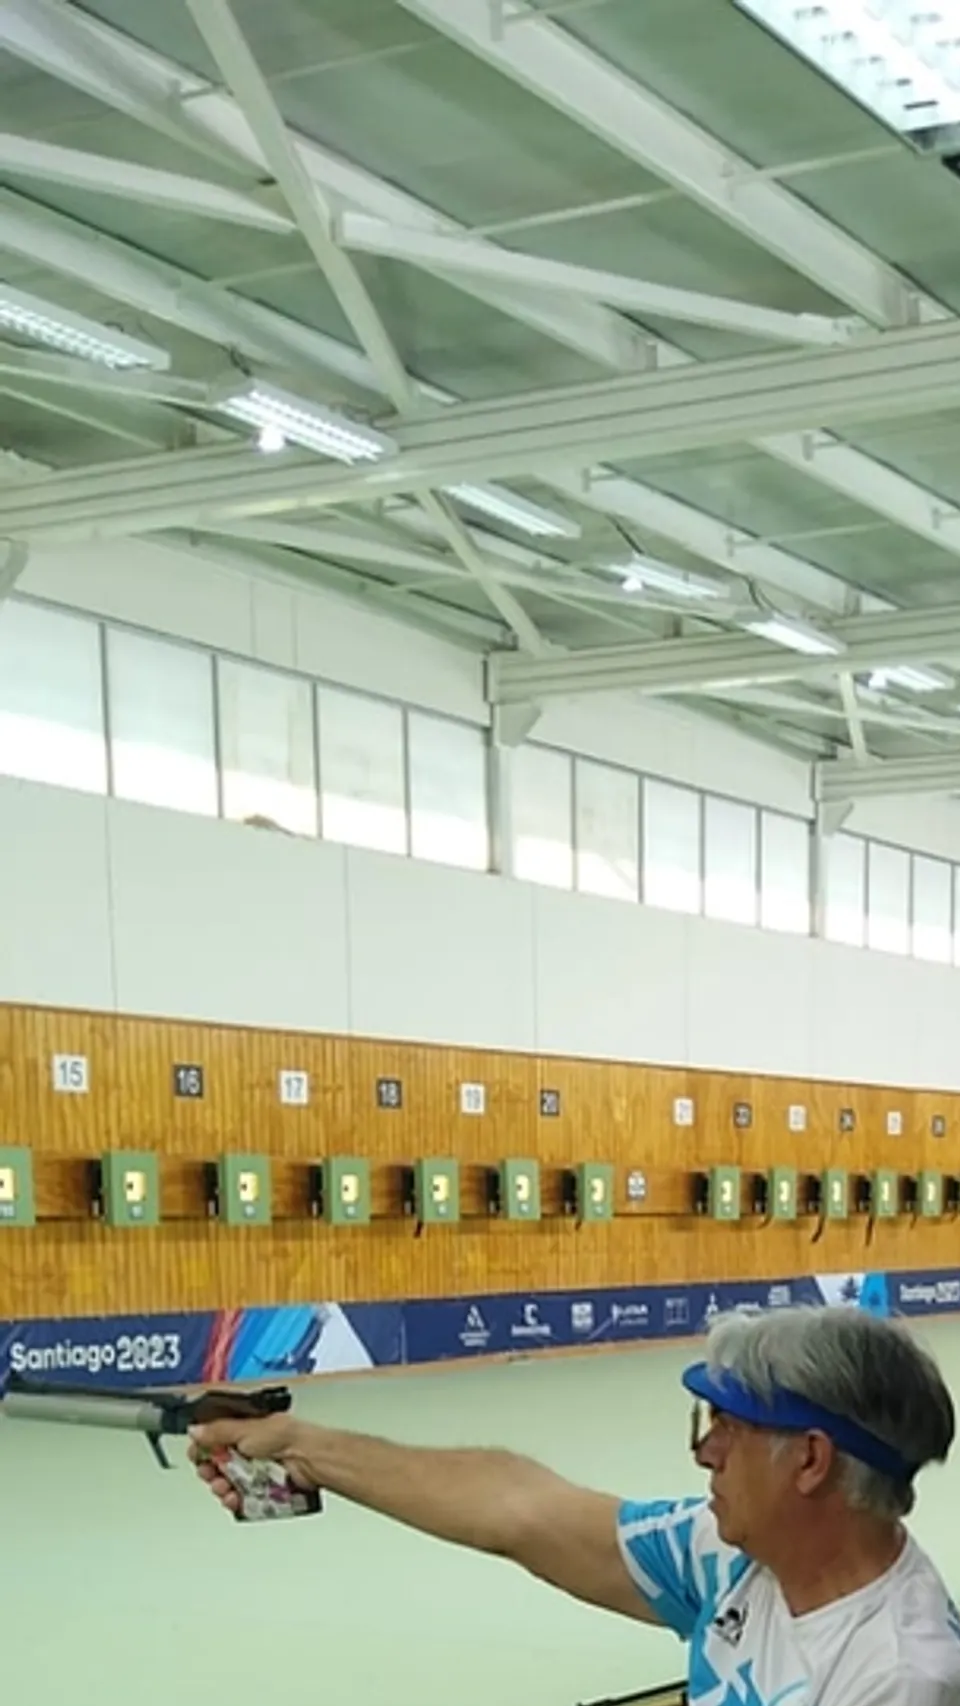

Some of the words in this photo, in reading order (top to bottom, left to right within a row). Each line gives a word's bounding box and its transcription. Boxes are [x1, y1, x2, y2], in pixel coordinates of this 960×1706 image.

[58, 1061, 84, 1086] 15
[176, 1068, 201, 1094] 16
[284, 1075, 304, 1099] 17
[379, 1082, 399, 1106] 18
[10, 1339, 115, 1373] Santiago
[116, 1333, 181, 1372] 2023
